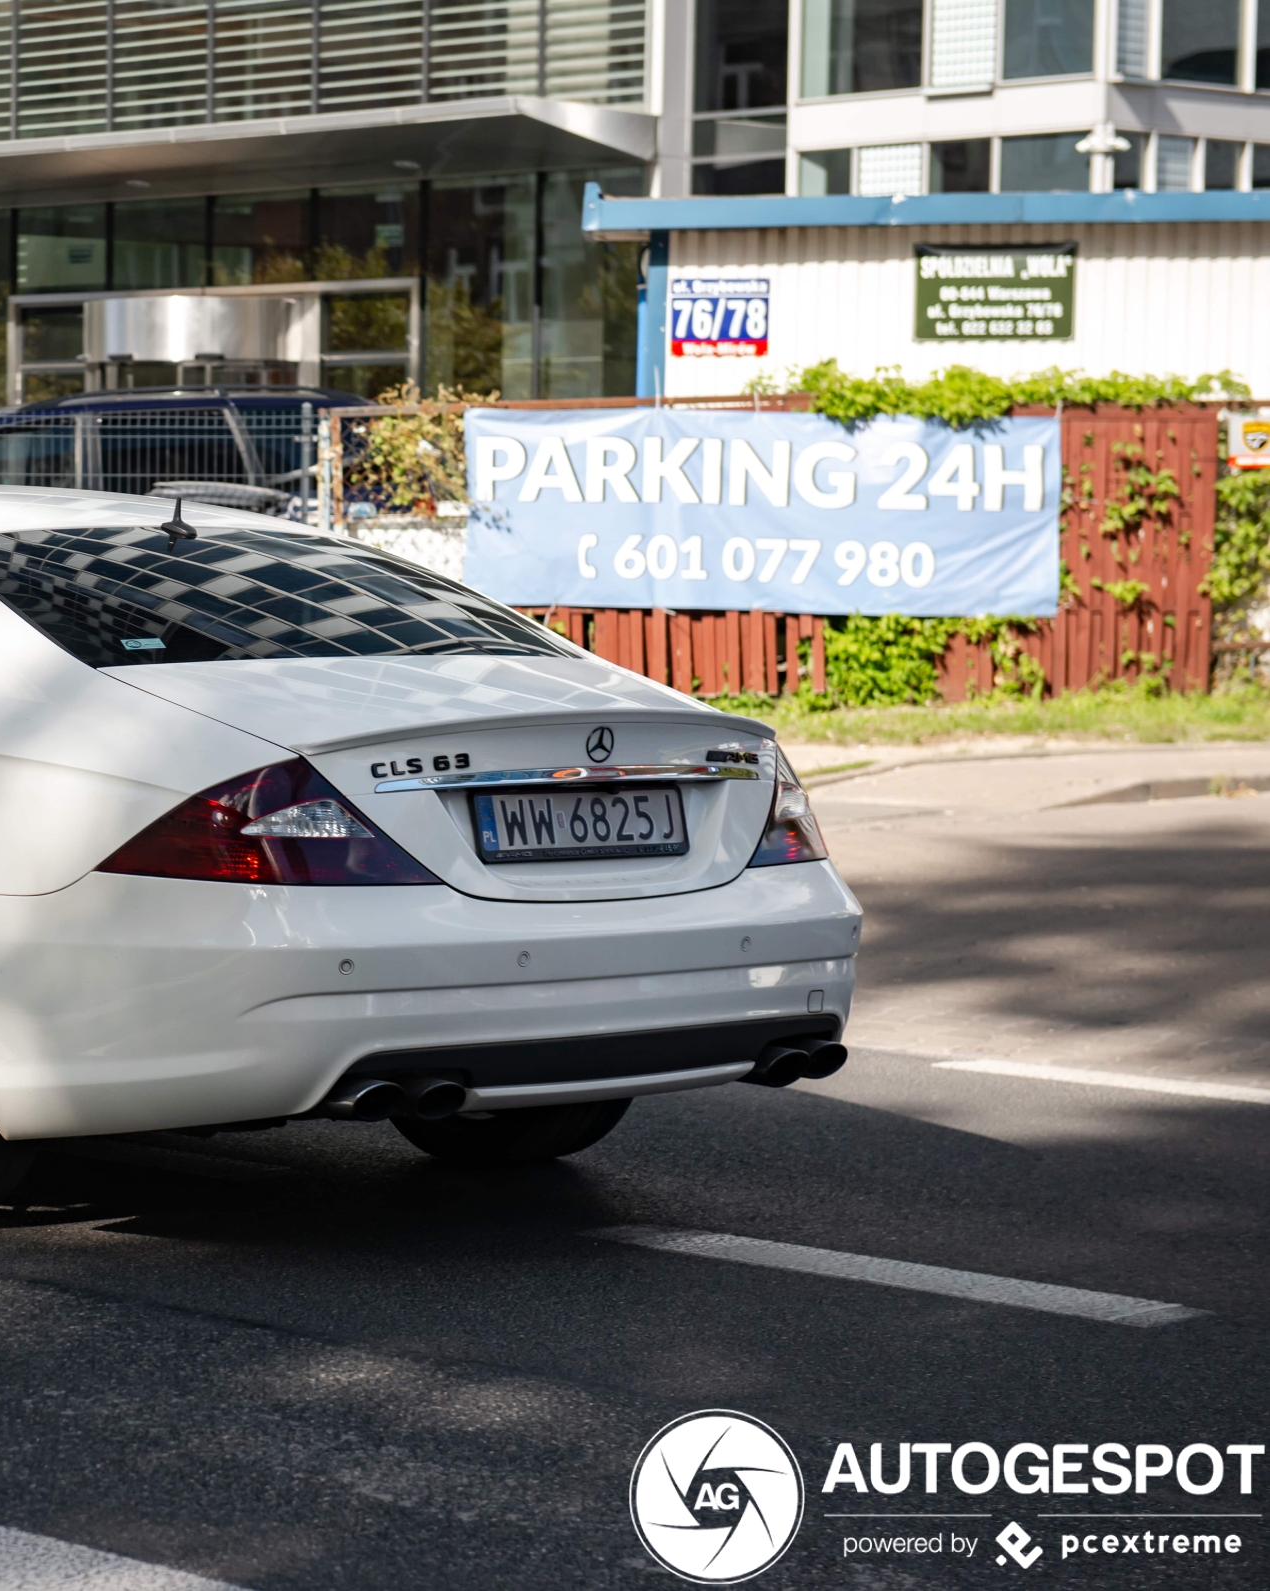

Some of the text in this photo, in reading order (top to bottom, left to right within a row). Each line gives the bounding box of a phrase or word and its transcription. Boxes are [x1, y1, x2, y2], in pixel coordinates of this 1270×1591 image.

[673, 298, 767, 341] 76/78
[474, 435, 1044, 512] PARKING 24H
[613, 534, 936, 588] 601 077 980
[370, 752, 471, 779] CLS 63
[482, 830, 497, 843] PL
[500, 794, 675, 846] WW 6825J
